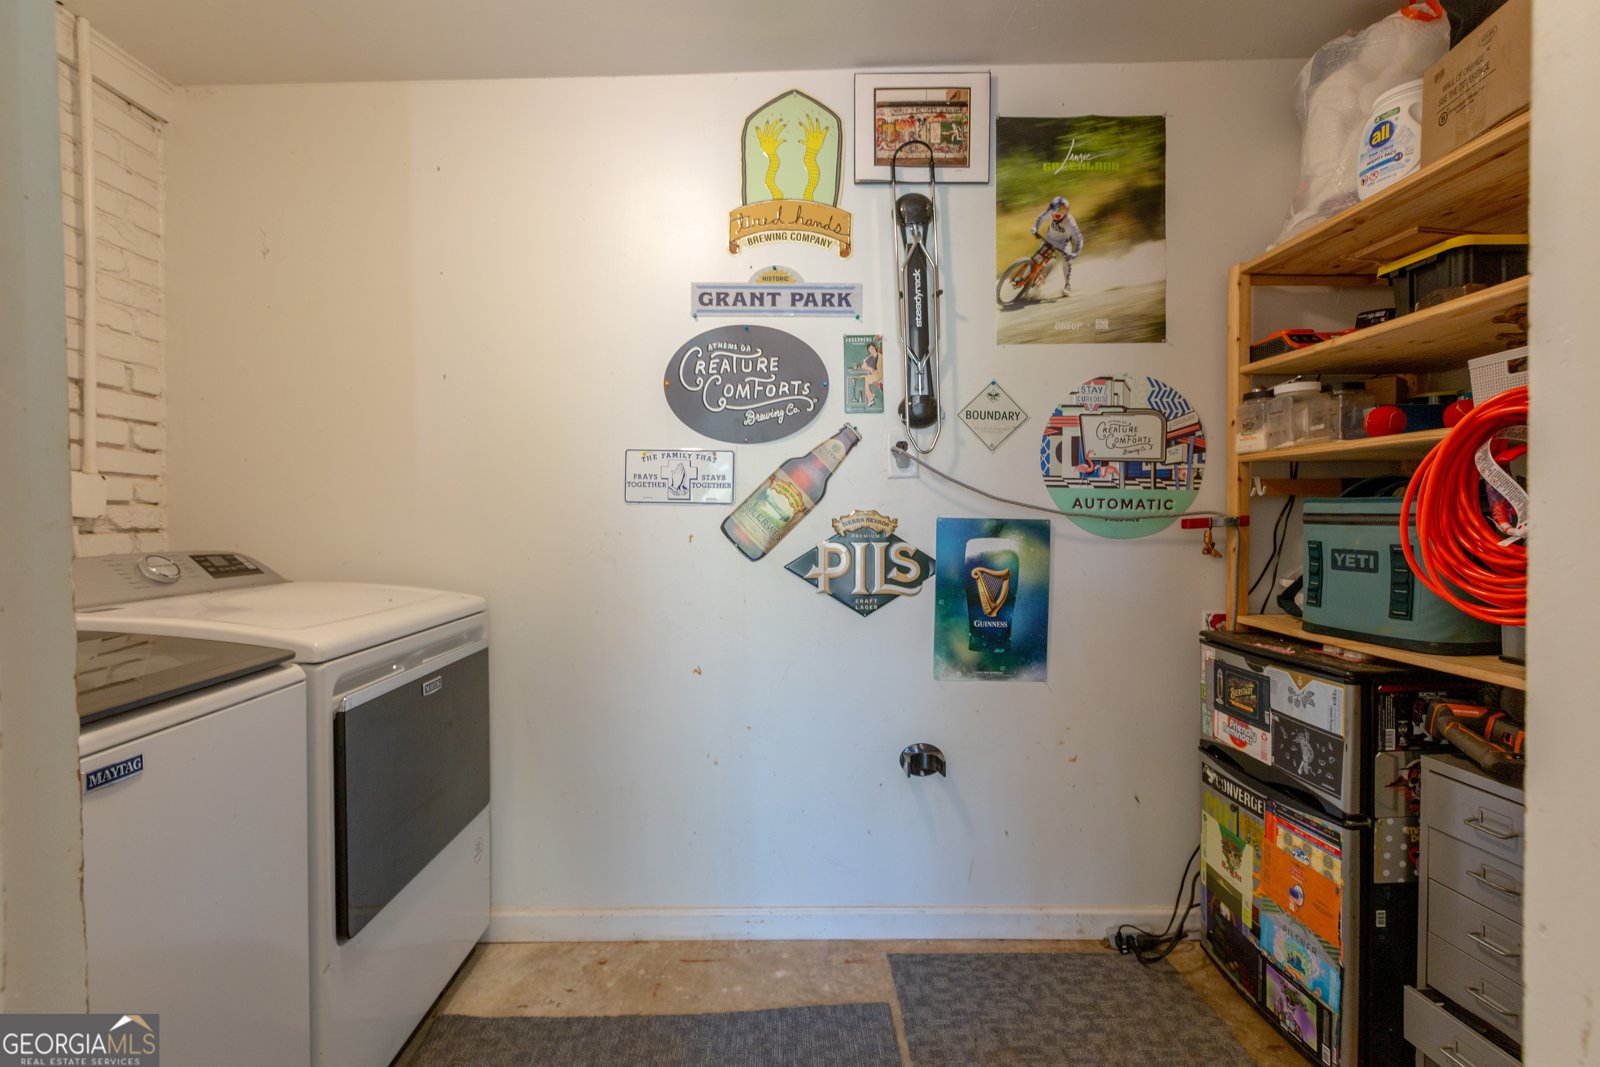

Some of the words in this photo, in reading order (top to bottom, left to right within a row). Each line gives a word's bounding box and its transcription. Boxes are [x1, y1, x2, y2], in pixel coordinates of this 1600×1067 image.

[1371, 123, 1390, 145] all
[731, 205, 784, 234] tired
[788, 205, 845, 234] hands
[748, 232, 788, 246] BREWING
[790, 232, 833, 248] COMPANY
[698, 292, 781, 307] GRANT
[790, 292, 852, 307] PARK
[913, 268, 923, 328] steadyrack
[679, 346, 780, 391] CREATURE
[703, 374, 811, 412] COMFORTS
[1081, 386, 1103, 394] STAY
[743, 408, 785, 426] Brewing
[786, 402, 801, 416] Co.
[965, 410, 1020, 421] BOUNDARY
[1096, 421, 1138, 440] CREATURE
[1106, 434, 1151, 449] COMFORTS
[641, 451, 658, 463] THE
[661, 451, 692, 461] FAMILY
[695, 452, 718, 464] THAT
[627, 481, 667, 489] TOGETHER
[633, 473, 659, 481] PRAYS
[702, 474, 727, 482] STAYS
[1072, 498, 1174, 511] AUTOMATIC
[842, 518, 865, 528] SIERRA
[865, 517, 890, 528] NEVADA
[1334, 552, 1374, 568] YETI
[803, 541, 923, 597] PILS
[974, 619, 1008, 628] GUINNESS
[88, 757, 142, 789] MAYTAG
[1215, 775, 1263, 815] CONVERGE
